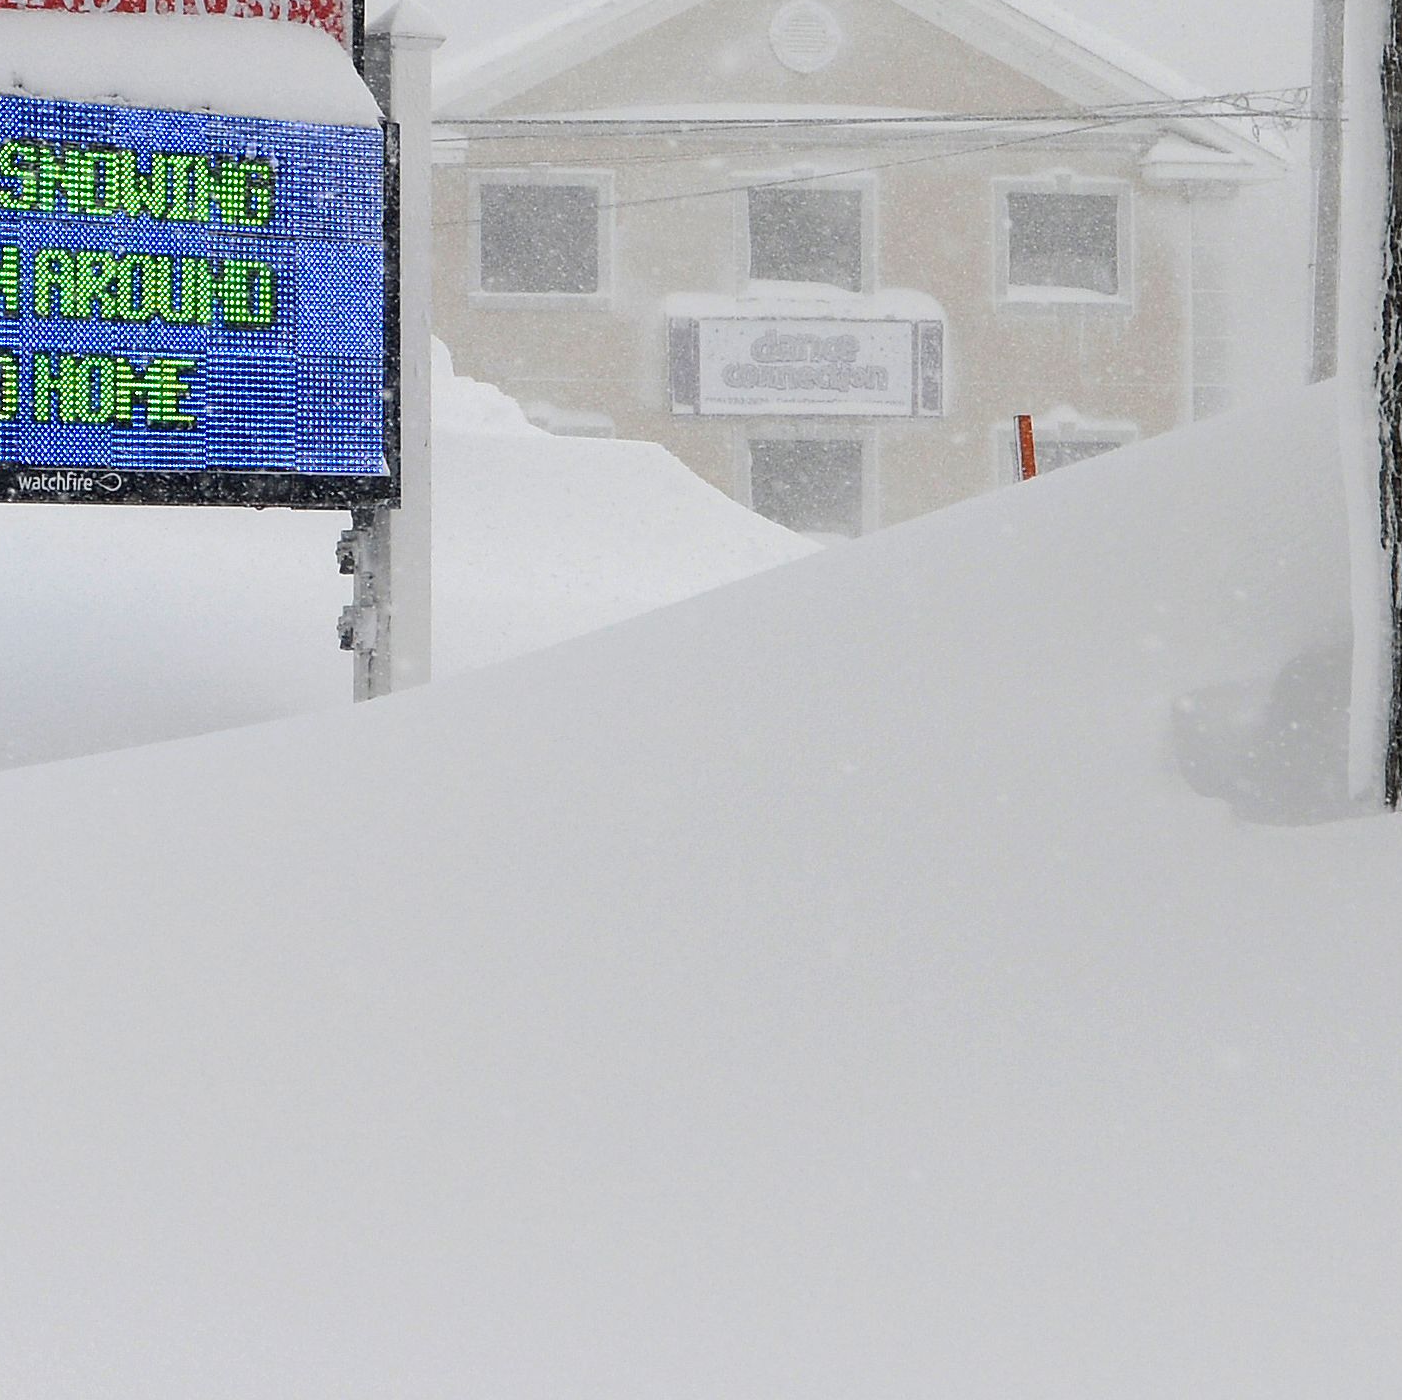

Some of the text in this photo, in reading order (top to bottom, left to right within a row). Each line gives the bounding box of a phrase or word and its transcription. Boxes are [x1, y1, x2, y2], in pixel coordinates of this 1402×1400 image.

[32, 248, 275, 324] AROUND
[32, 353, 196, 424] HOME
[18, 472, 93, 491] watchfire
